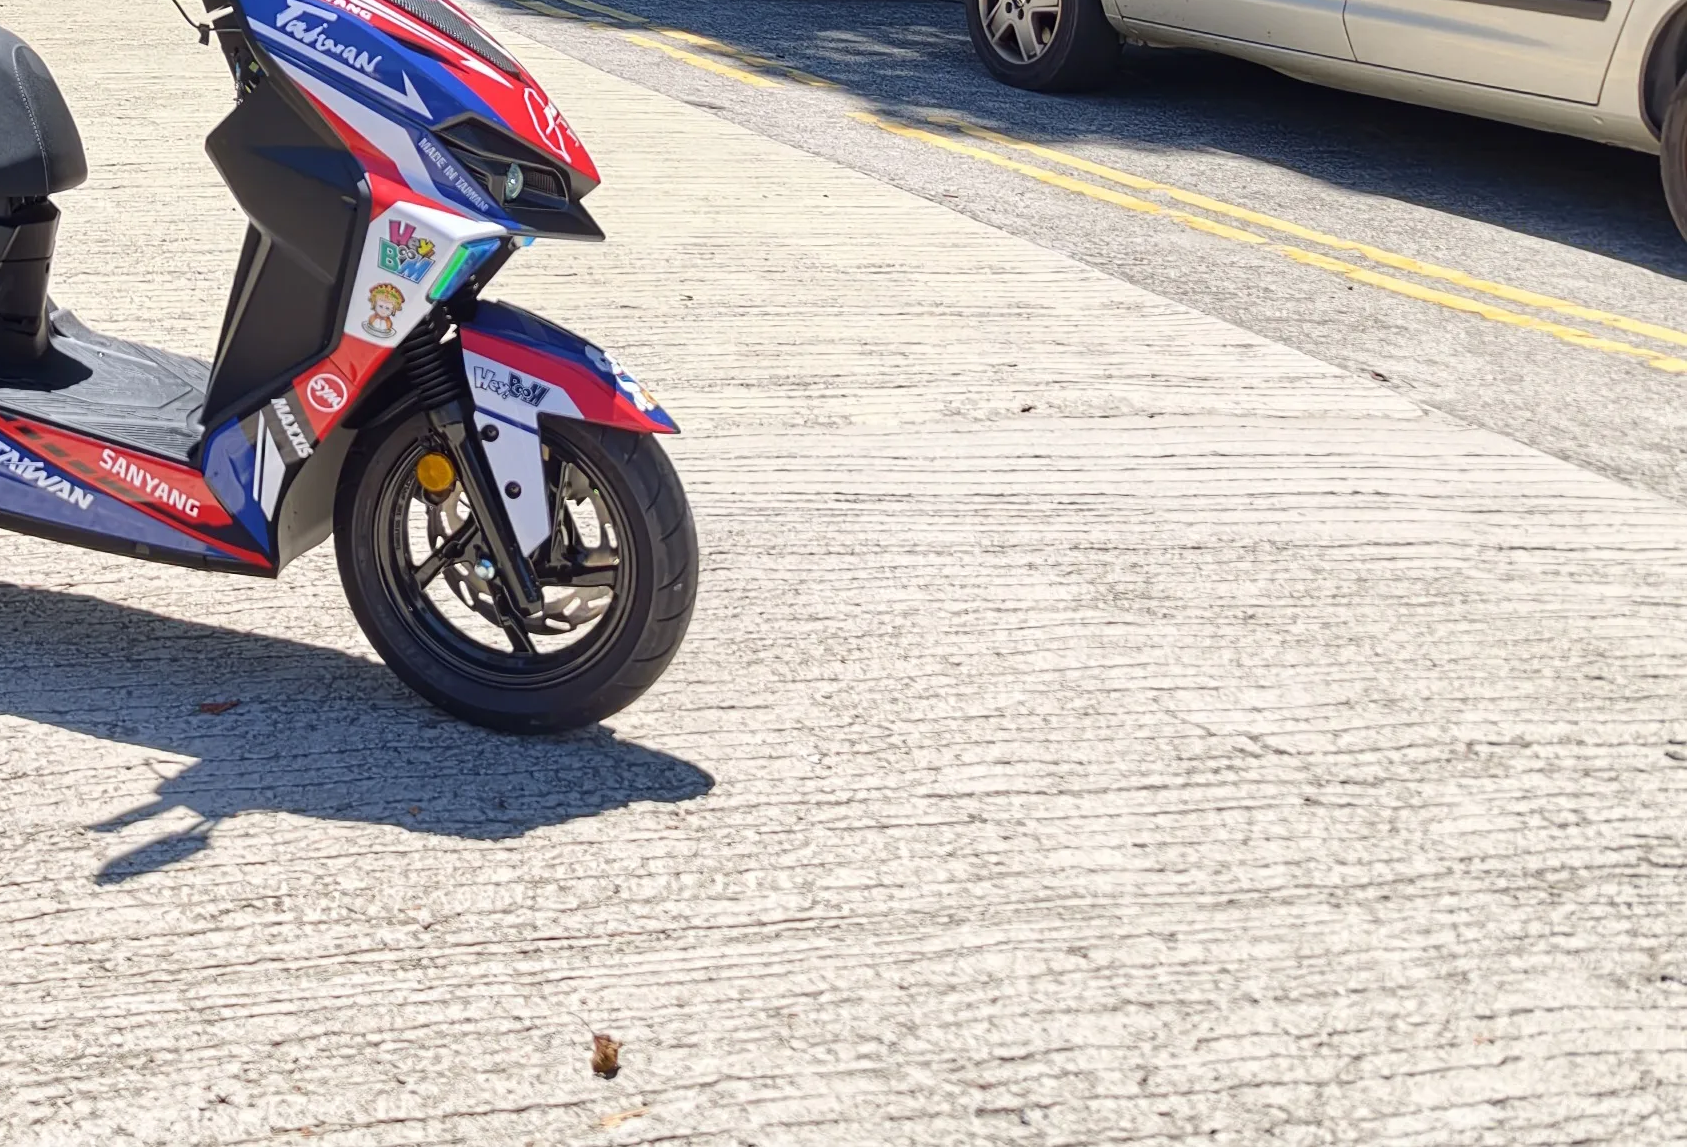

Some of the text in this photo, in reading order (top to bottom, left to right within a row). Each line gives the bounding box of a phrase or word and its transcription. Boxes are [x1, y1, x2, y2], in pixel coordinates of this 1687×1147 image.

[418, 137, 490, 213] MADE IN TAIWAN
[311, 377, 343, 409] SYM
[270, 397, 315, 459] MAXXIS
[98, 447, 201, 519] SANYANG
